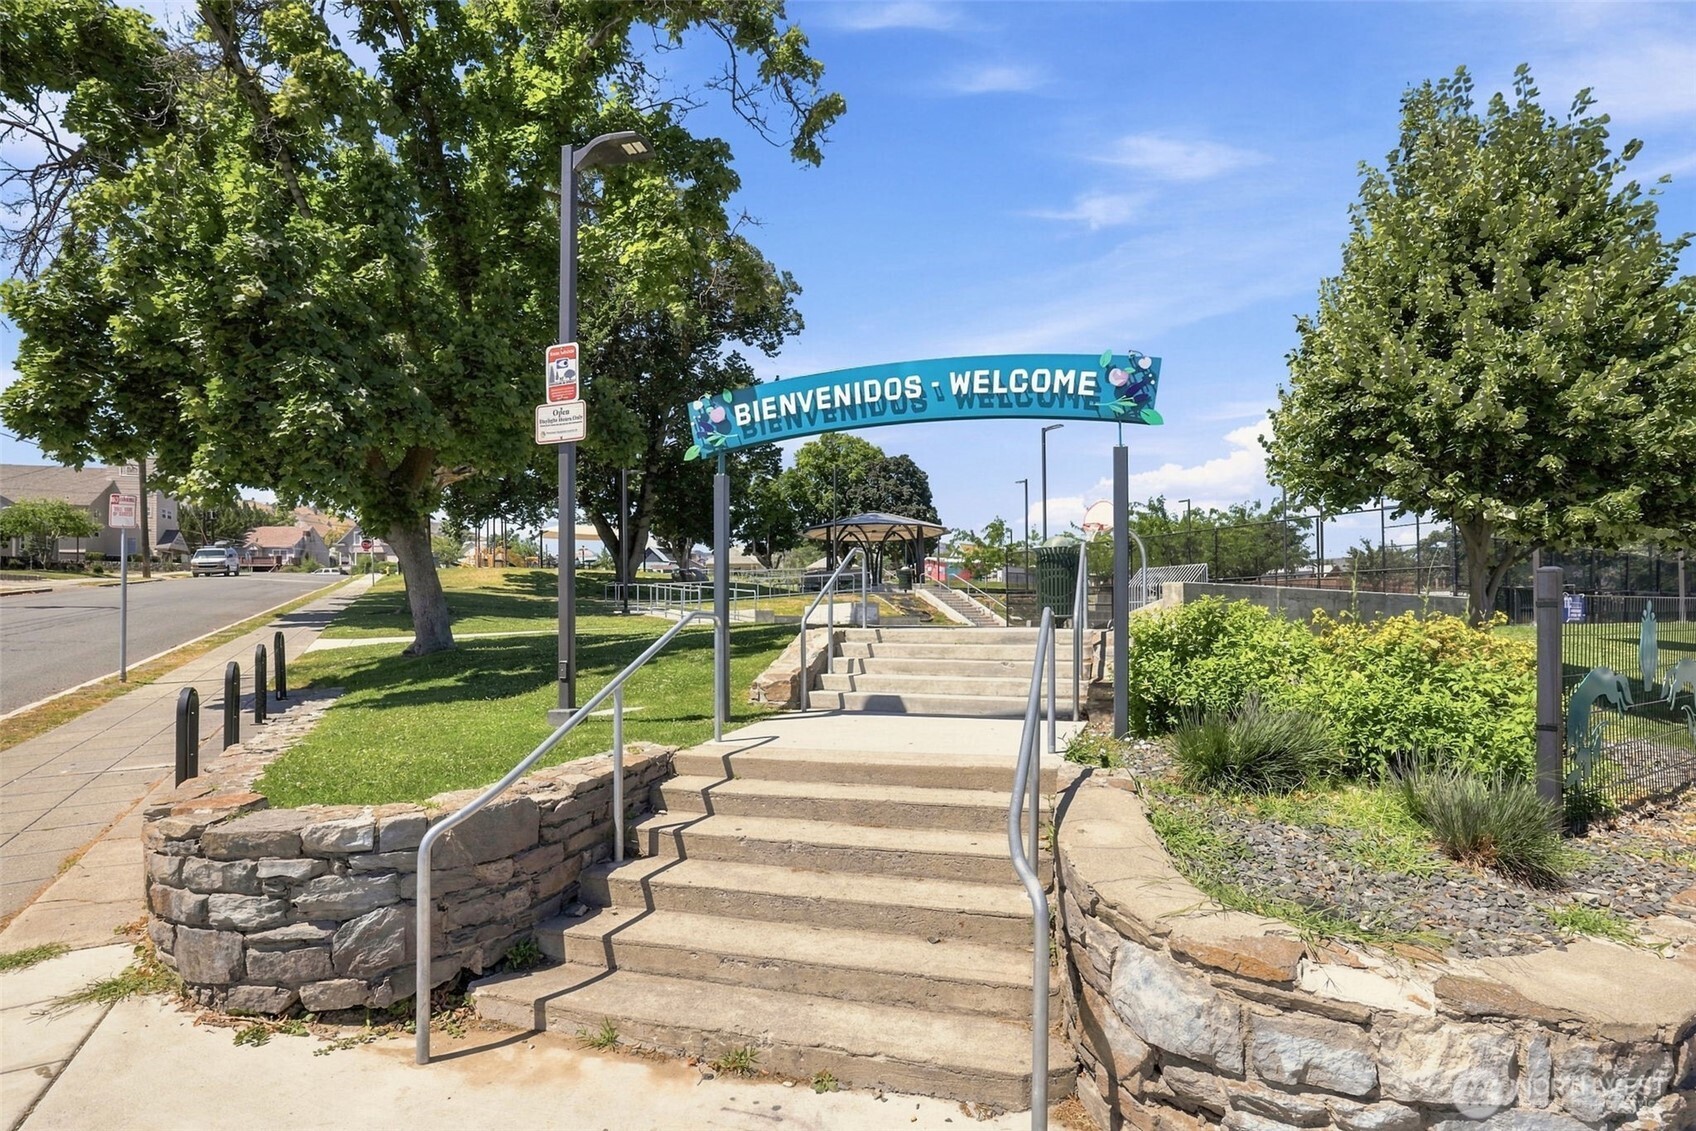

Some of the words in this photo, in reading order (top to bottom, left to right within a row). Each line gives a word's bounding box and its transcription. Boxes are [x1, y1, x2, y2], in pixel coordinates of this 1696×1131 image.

[552, 409, 570, 417] Open
[734, 375, 922, 426] BIENVENIDOS
[949, 368, 1098, 396] WELCOME
